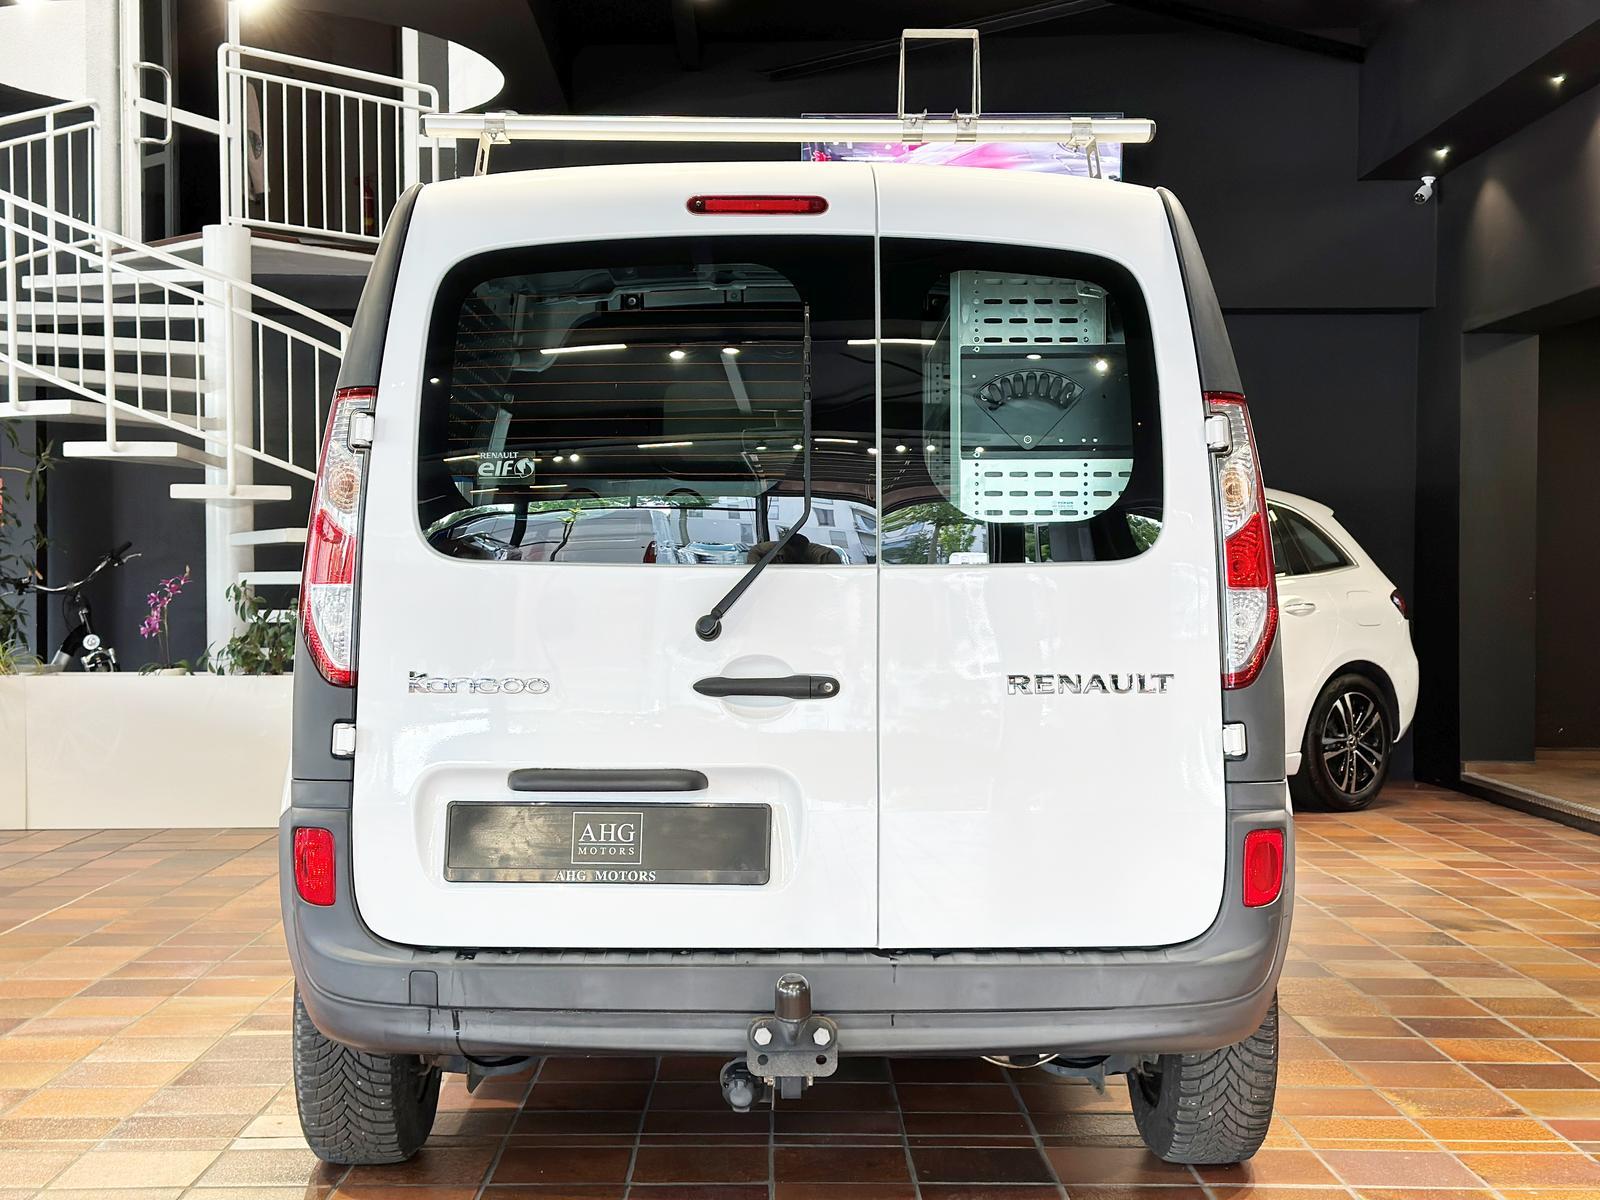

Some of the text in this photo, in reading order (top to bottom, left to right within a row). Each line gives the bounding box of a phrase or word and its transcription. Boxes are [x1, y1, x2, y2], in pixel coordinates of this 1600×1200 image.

[480, 451, 519, 459] RENAULT
[478, 460, 514, 476] elf
[1006, 673, 1175, 695] RENAULT
[578, 822, 636, 842] AHG
[578, 846, 635, 855] MOTORS
[555, 870, 656, 881] AHG MOTORS
